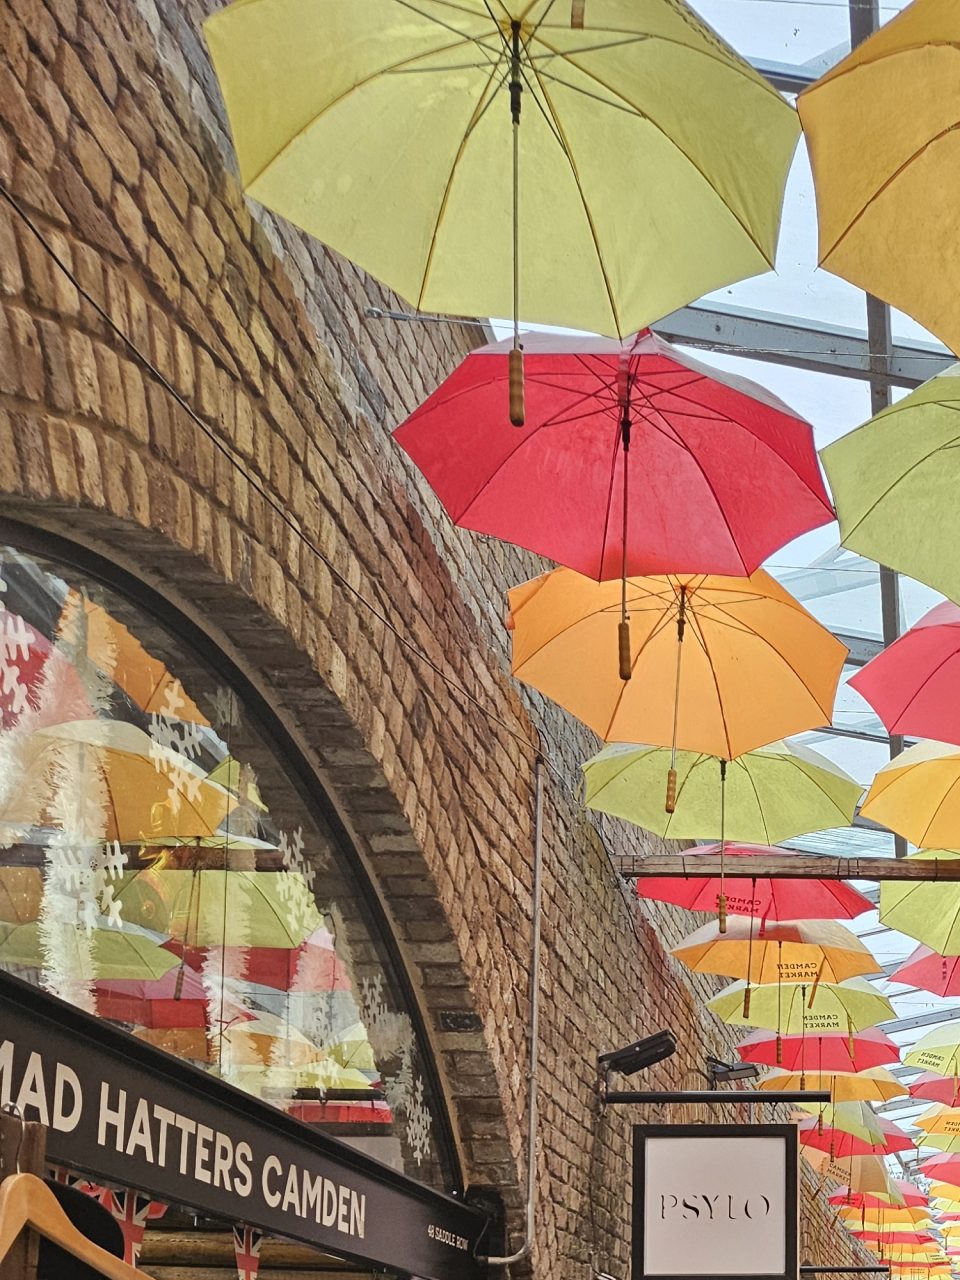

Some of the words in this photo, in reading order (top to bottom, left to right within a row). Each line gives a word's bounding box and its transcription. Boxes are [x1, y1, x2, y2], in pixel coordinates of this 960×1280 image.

[98, 1082, 253, 1198] HATTERS
[262, 1155, 366, 1239] CAMDEN
[660, 1194, 771, 1220] PSYLO
